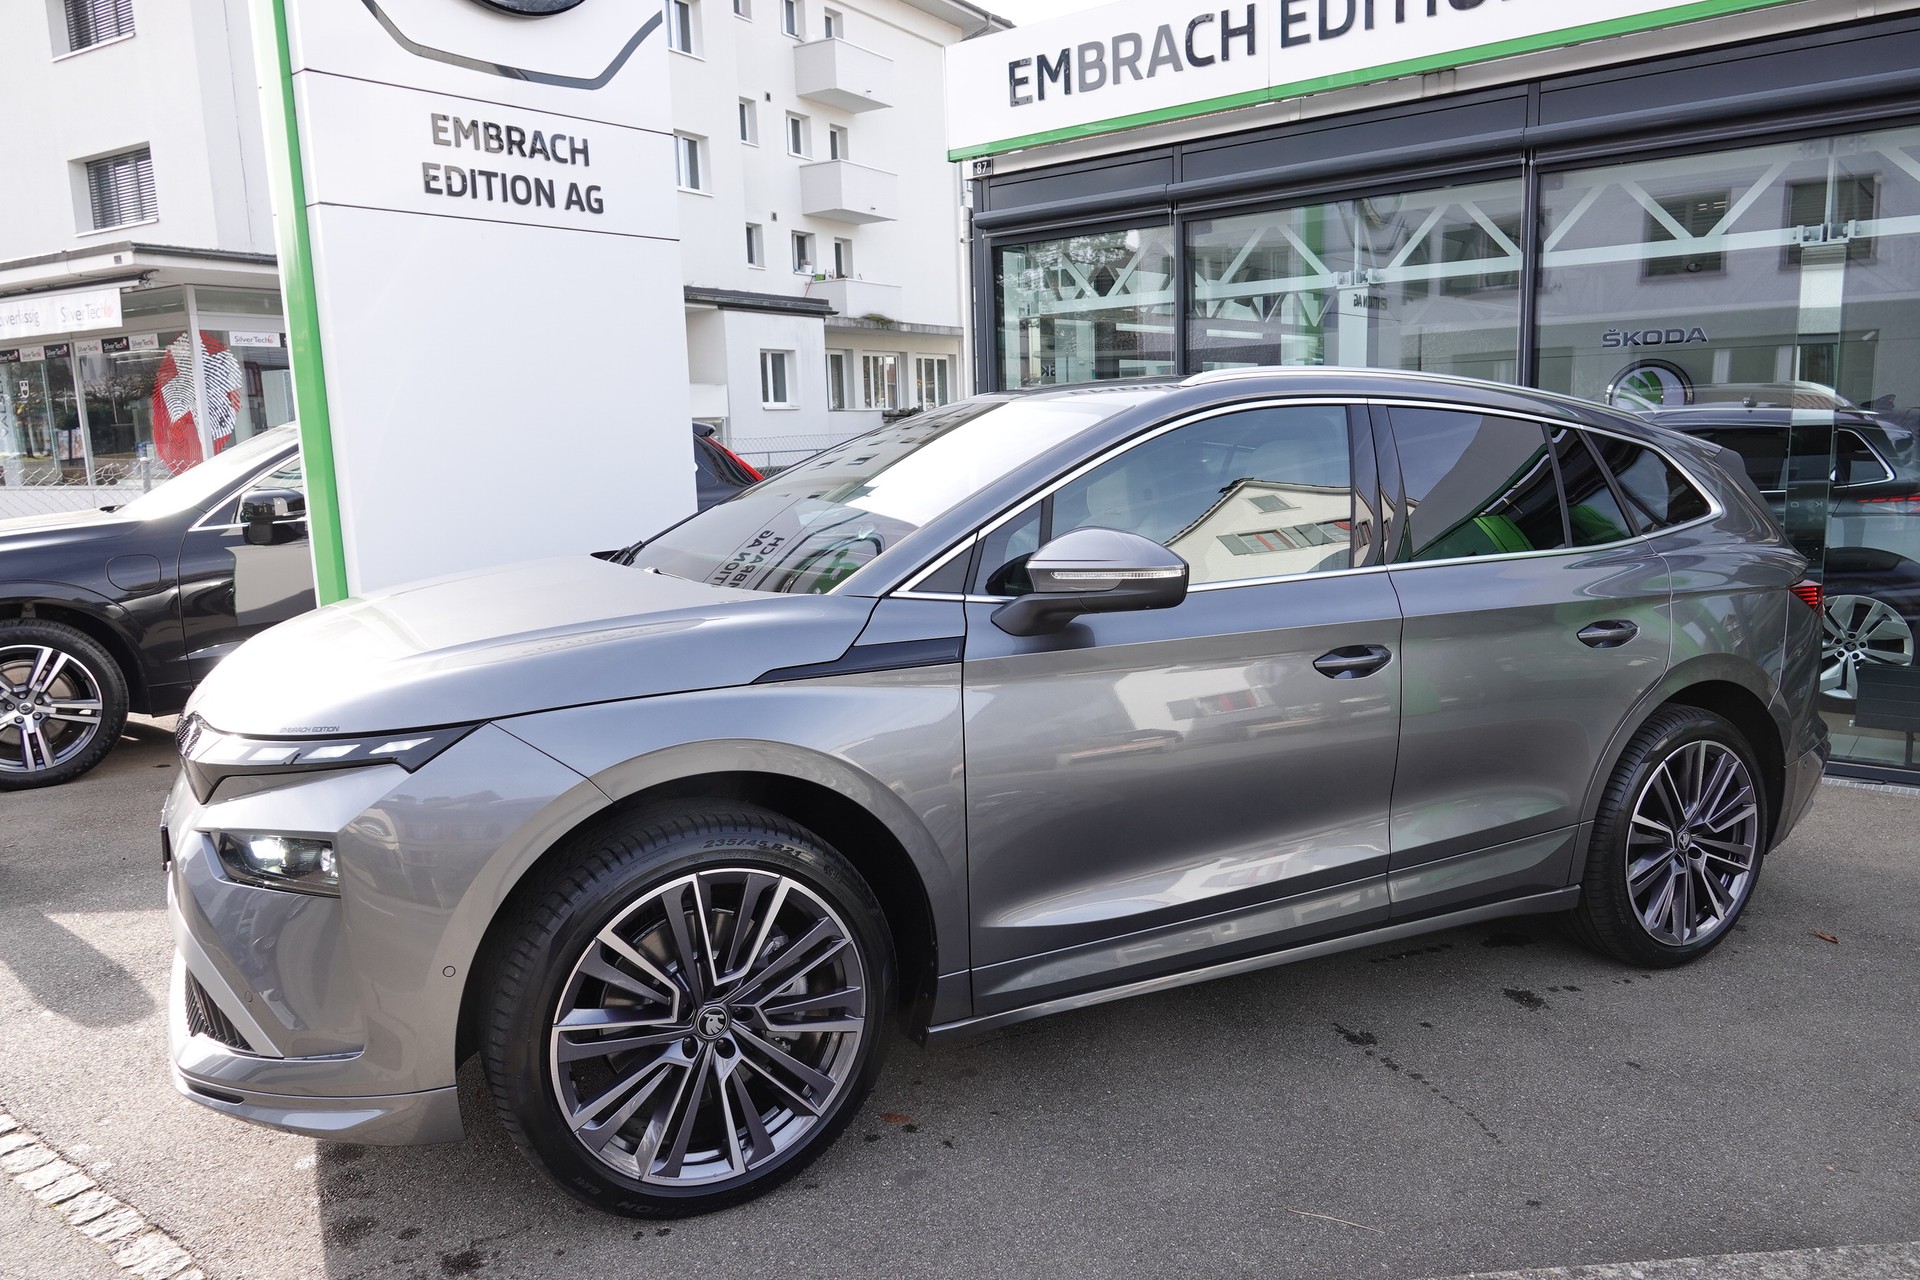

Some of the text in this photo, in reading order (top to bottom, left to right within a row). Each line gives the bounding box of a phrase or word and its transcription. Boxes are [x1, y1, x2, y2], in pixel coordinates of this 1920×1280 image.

[1009, 3, 1256, 107] EMBRACH
[431, 112, 590, 167] EMBRACH
[422, 161, 605, 215] EDITION AG
[976, 161, 988, 175] 87
[1602, 327, 1708, 348] ŠKODA
